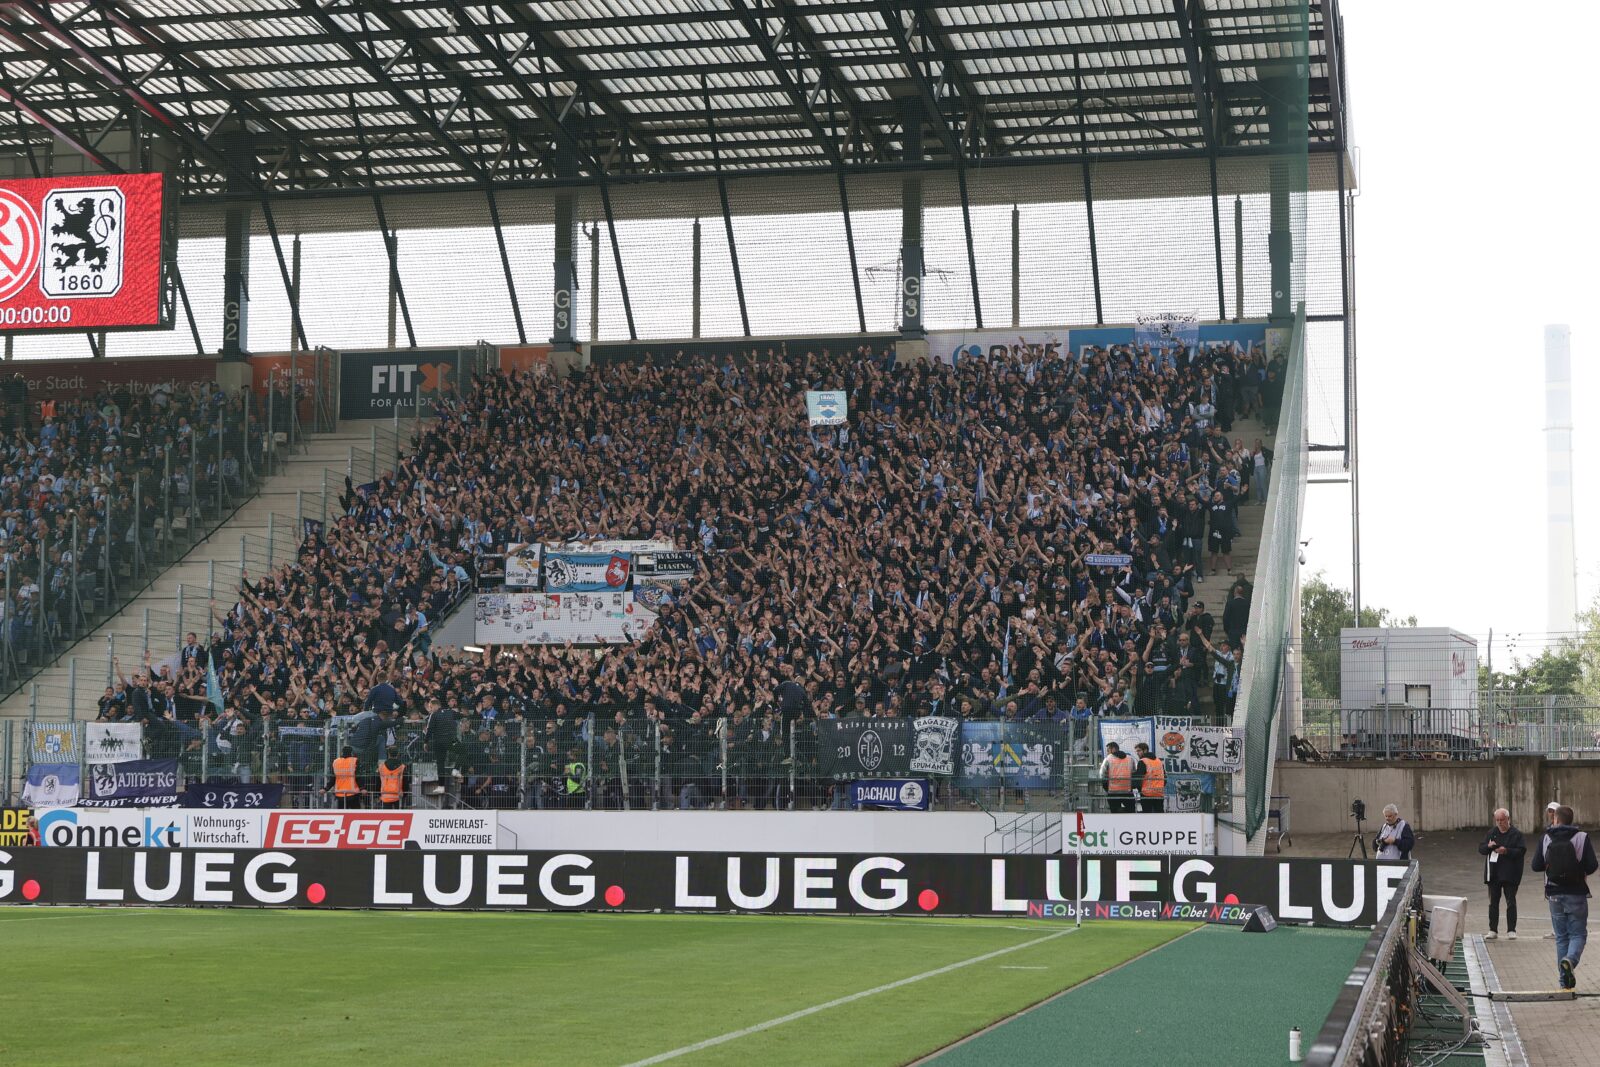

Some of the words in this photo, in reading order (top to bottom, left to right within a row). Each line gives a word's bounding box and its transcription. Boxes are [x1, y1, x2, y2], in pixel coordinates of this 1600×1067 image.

[58, 275, 103, 291] 1860
[46, 375, 88, 390] Stadt.
[370, 398, 392, 408] FOR
[396, 398, 415, 407] ALL
[1351, 637, 1378, 650] Ulrich
[117, 773, 176, 788] AMBERG
[857, 786, 897, 801] DACHAU
[38, 809, 181, 848] Connekt
[193, 815, 251, 831] Wohnungs-
[428, 818, 489, 830] SCHWERLAST-
[193, 831, 249, 844] Wirtschaft.
[424, 834, 493, 845] NUTZFAHRZEUGE
[1067, 829, 1109, 848] sat
[1119, 830, 1198, 846] GRUPPE
